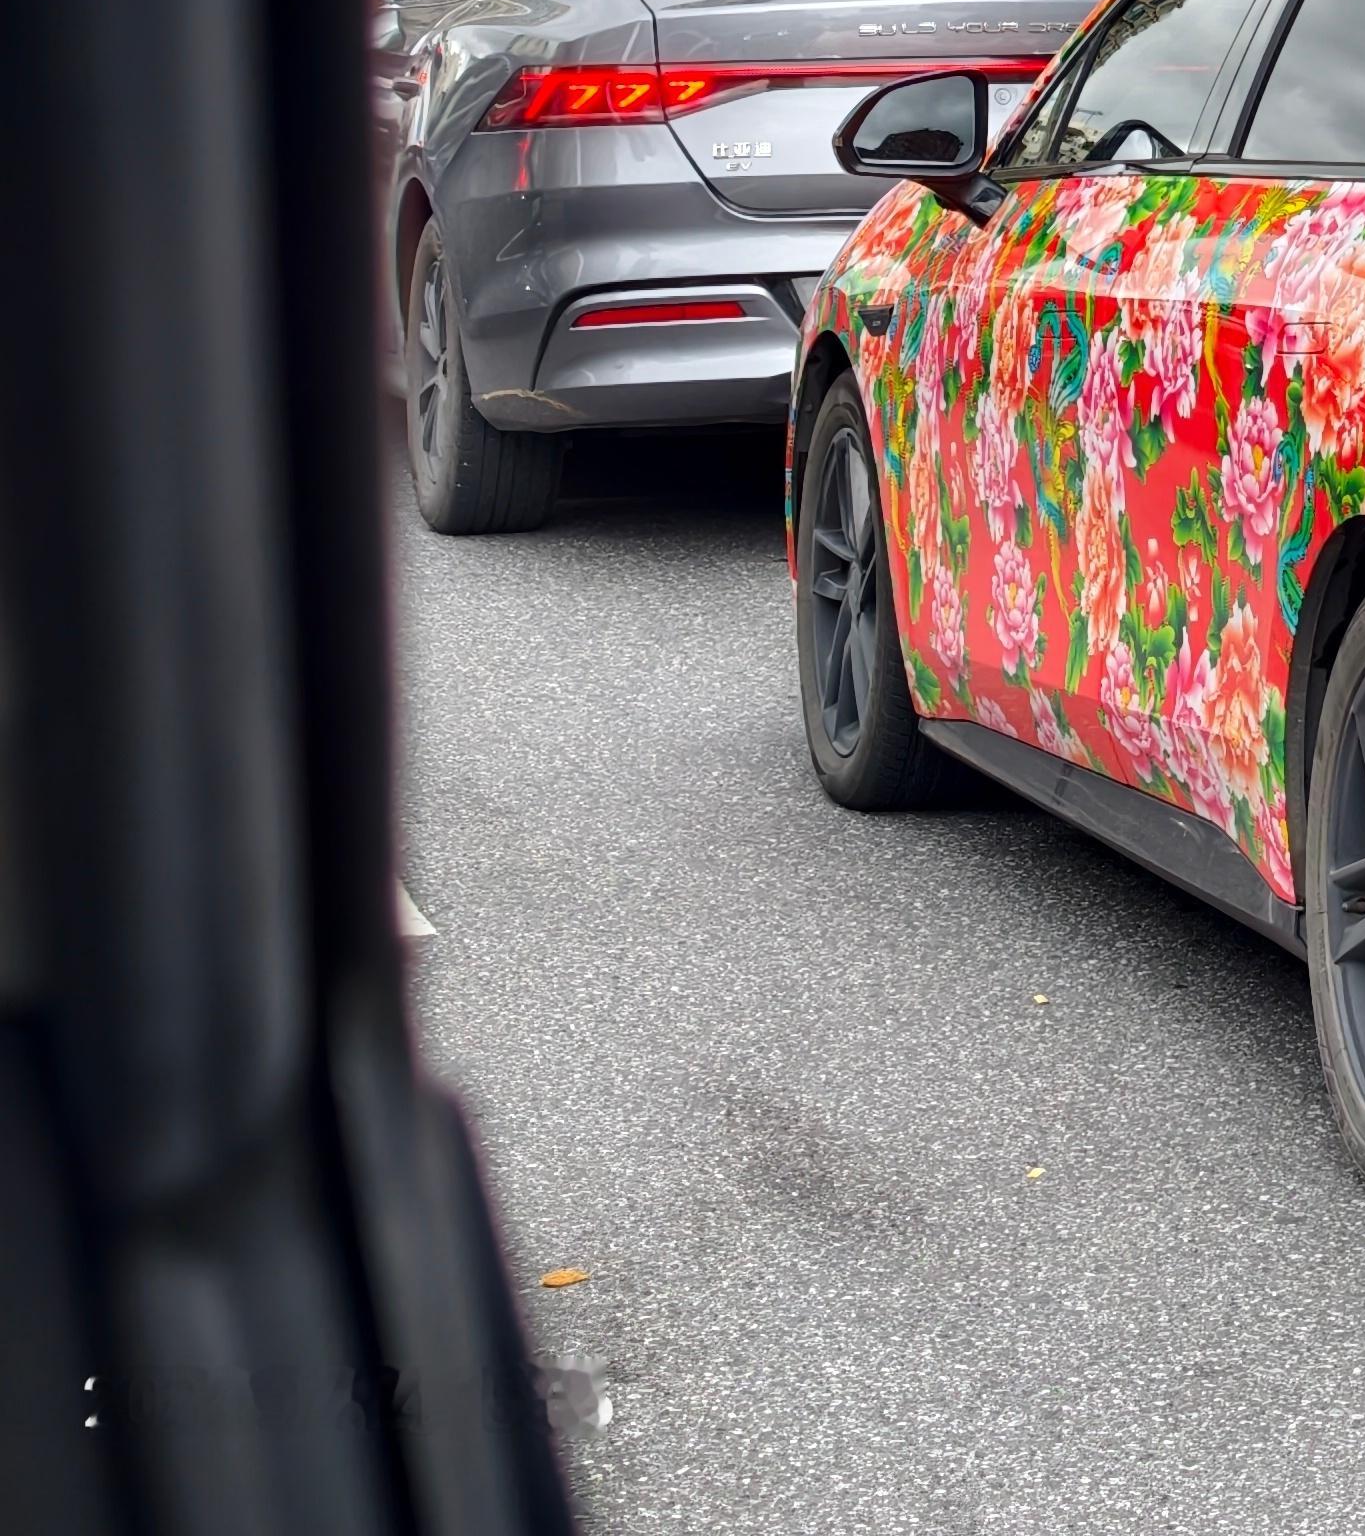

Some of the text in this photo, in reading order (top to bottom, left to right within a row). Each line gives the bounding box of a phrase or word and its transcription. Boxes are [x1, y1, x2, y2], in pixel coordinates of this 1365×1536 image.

[858, 21, 937, 37] BUILD
[947, 21, 1019, 33] YOUR
[712, 142, 772, 159] 比亚迪
[726, 161, 752, 171] EV
